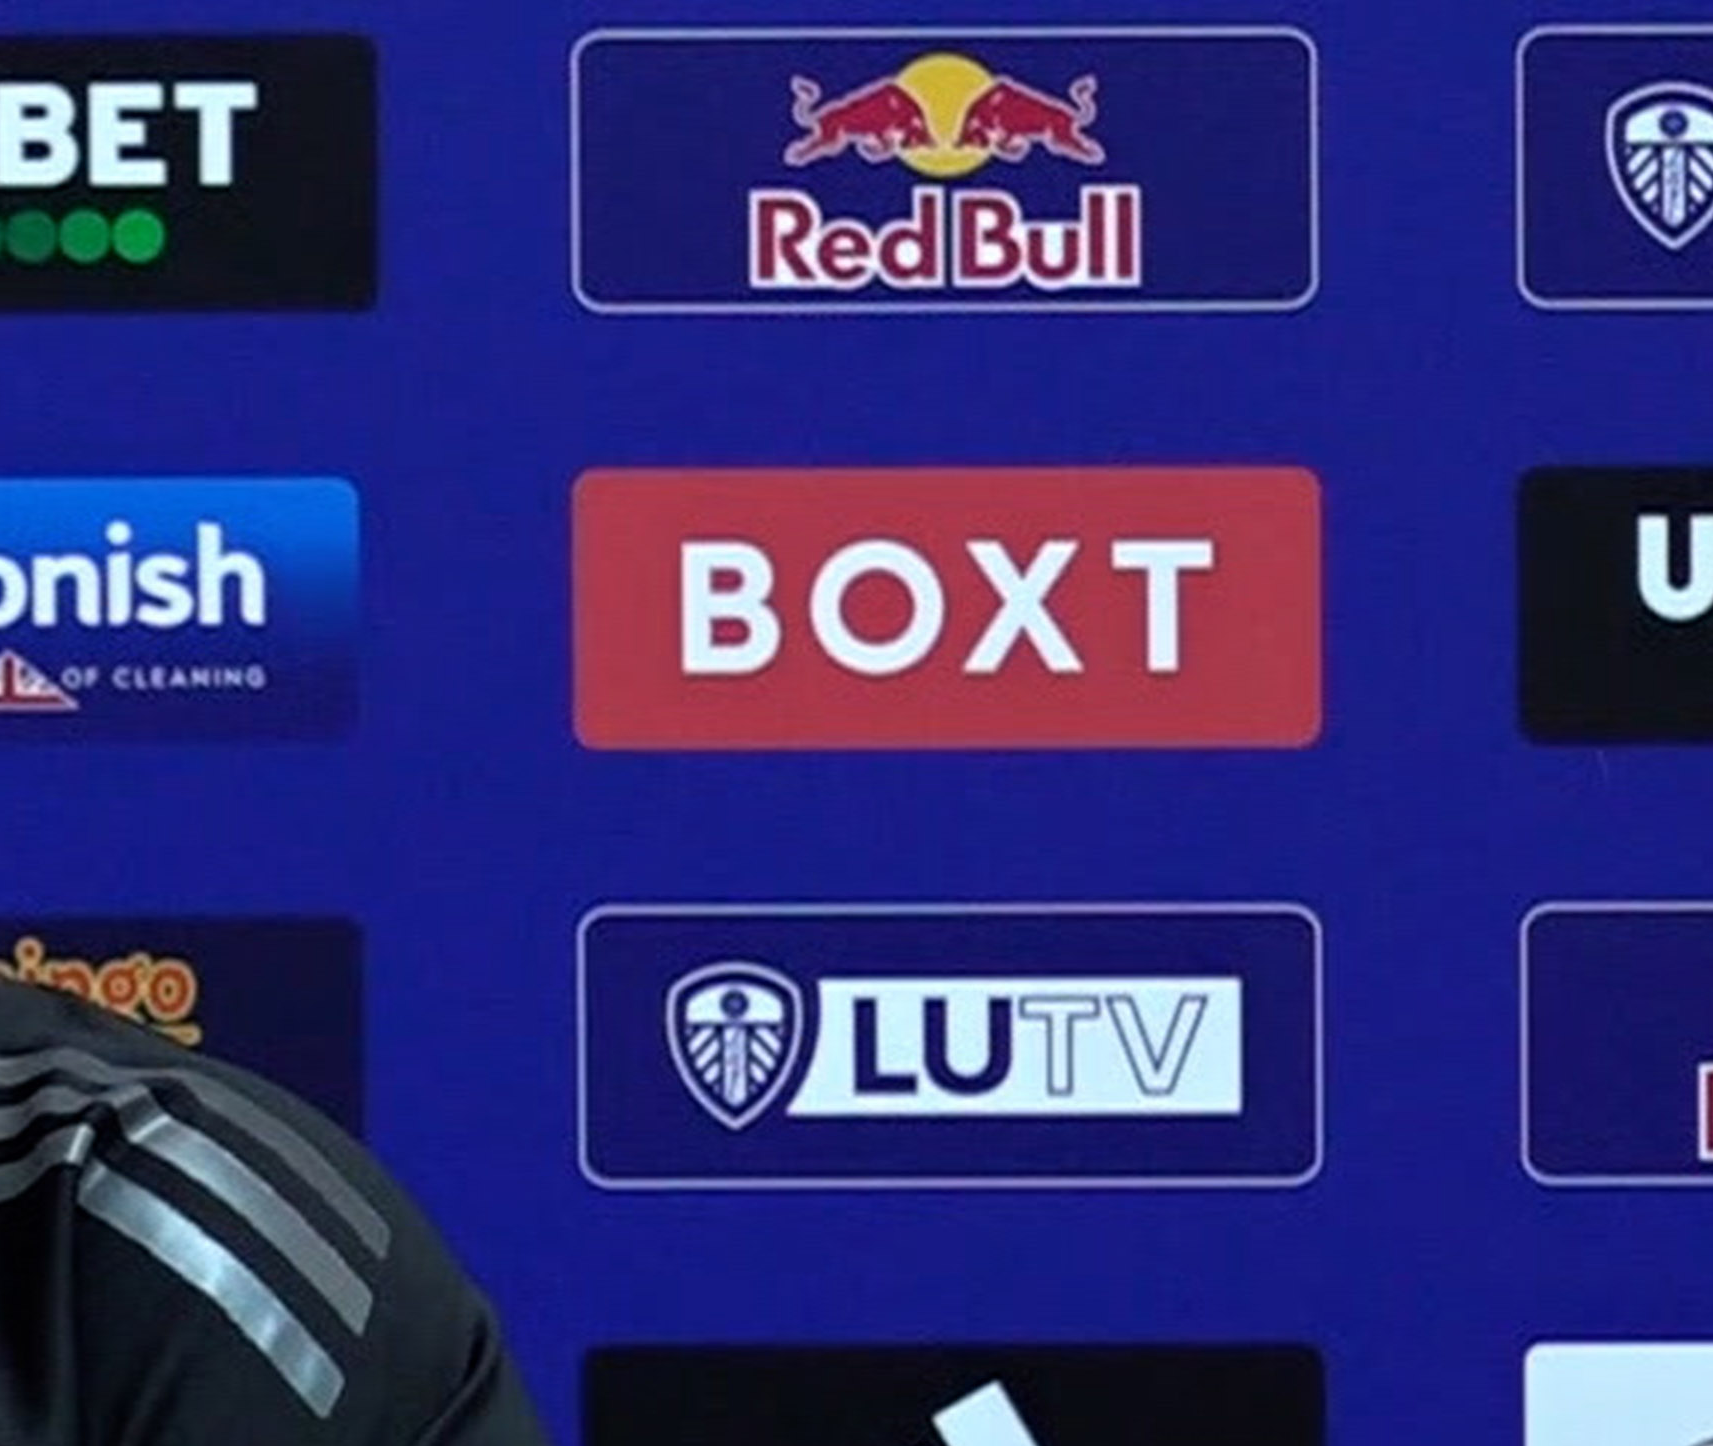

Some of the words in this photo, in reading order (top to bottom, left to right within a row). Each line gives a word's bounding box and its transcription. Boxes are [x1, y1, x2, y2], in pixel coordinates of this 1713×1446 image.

[749, 184, 946, 288] Red
[953, 184, 1142, 291] Bull
[680, 536, 1213, 676] BOXT
[60, 666, 99, 689] OF
[112, 665, 266, 689] CLEANING
[851, 994, 1209, 1096] LUTV
